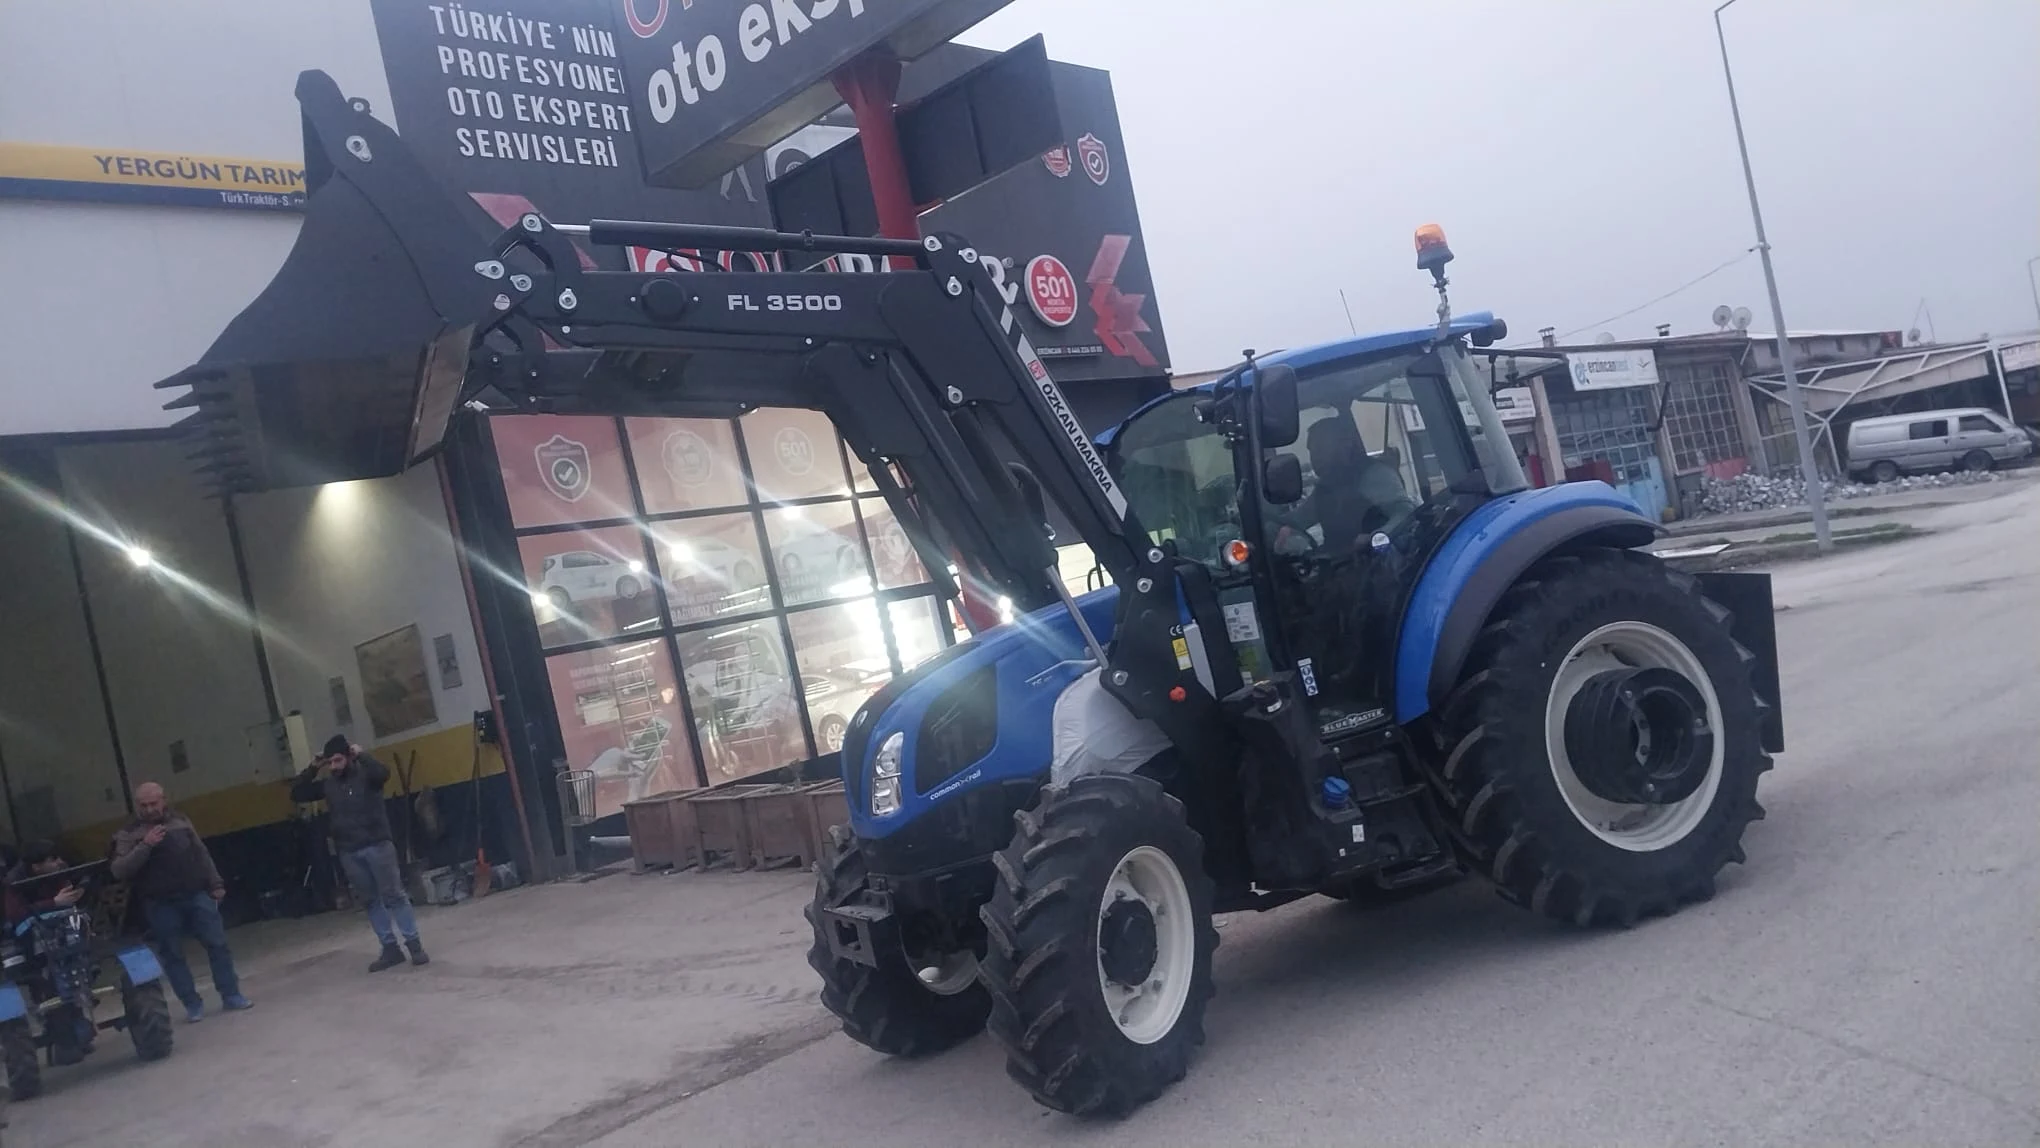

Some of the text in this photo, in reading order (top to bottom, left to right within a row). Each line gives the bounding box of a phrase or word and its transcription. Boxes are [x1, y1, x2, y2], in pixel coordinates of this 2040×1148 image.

[437, 45, 626, 94] PROFESYONE
[648, 35, 726, 123] oto
[447, 86, 632, 132] OTO EKSPERT
[94, 154, 221, 181] YERGÜN
[727, 294, 842, 311] FL 3500
[1036, 275, 1070, 298] 501
[1074, 434, 1113, 493] MAKİNA
[930, 769, 981, 800] common rail
